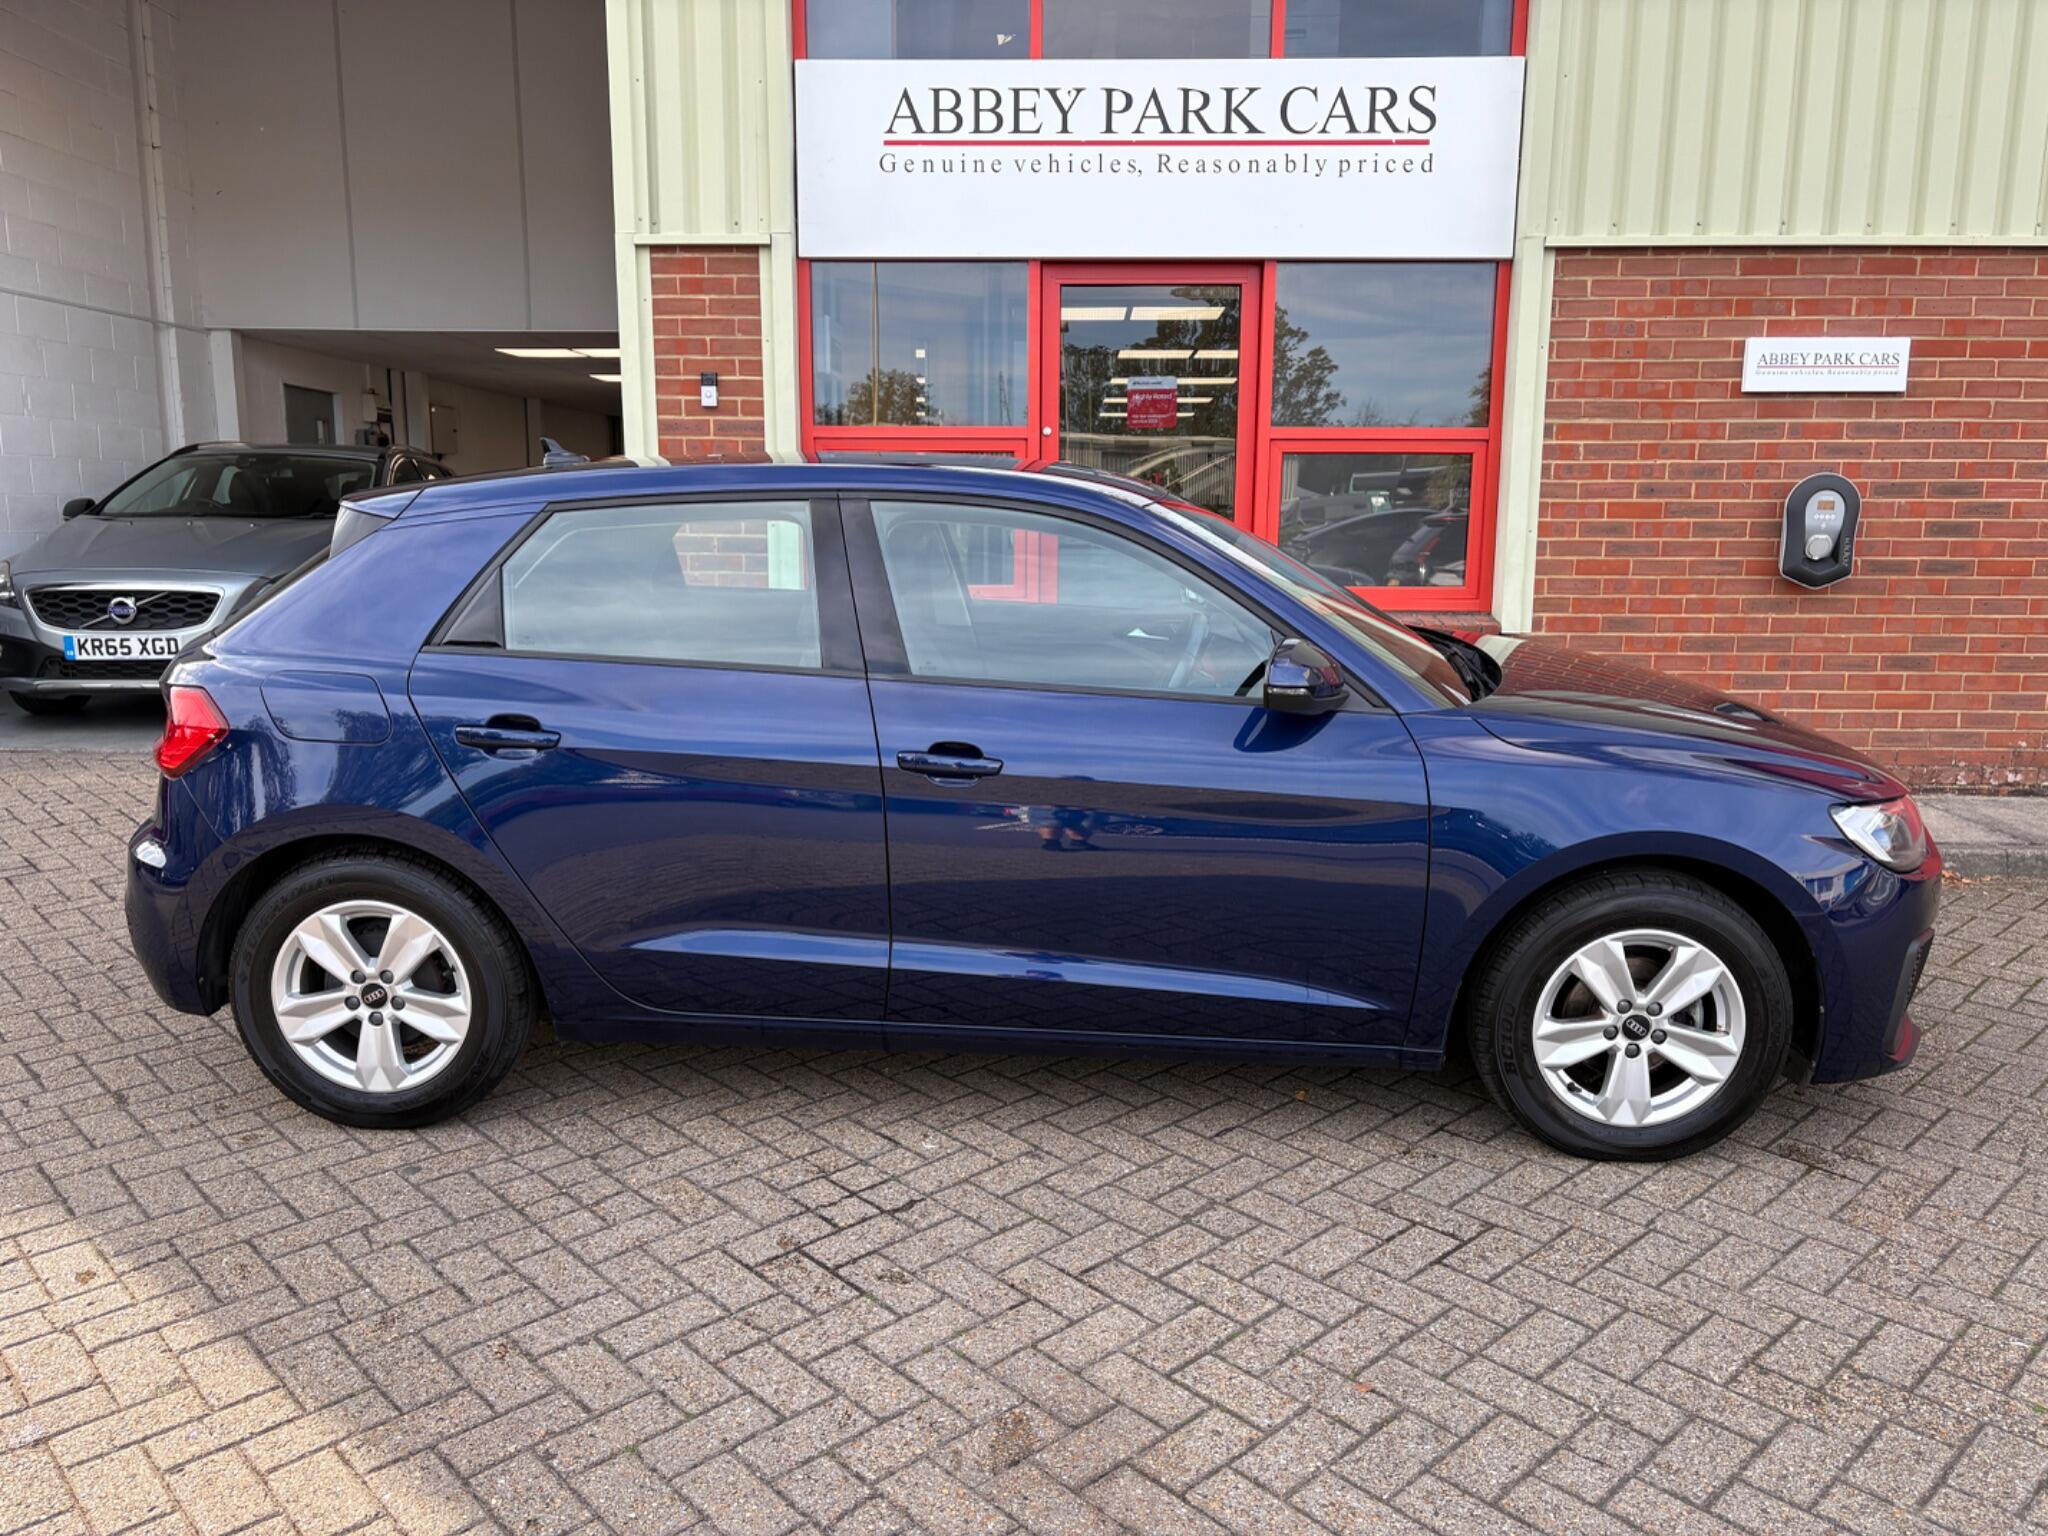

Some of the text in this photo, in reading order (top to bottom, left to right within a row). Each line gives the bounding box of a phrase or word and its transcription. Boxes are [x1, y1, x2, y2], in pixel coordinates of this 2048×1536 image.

[885, 86, 1437, 134] ABBEY PARK CARS
[879, 153, 1434, 178] Genuine vehicles, Reasonably priced
[1757, 352, 1900, 365] ABBEY PARK CARS
[77, 637, 179, 656] KR65 XGD
